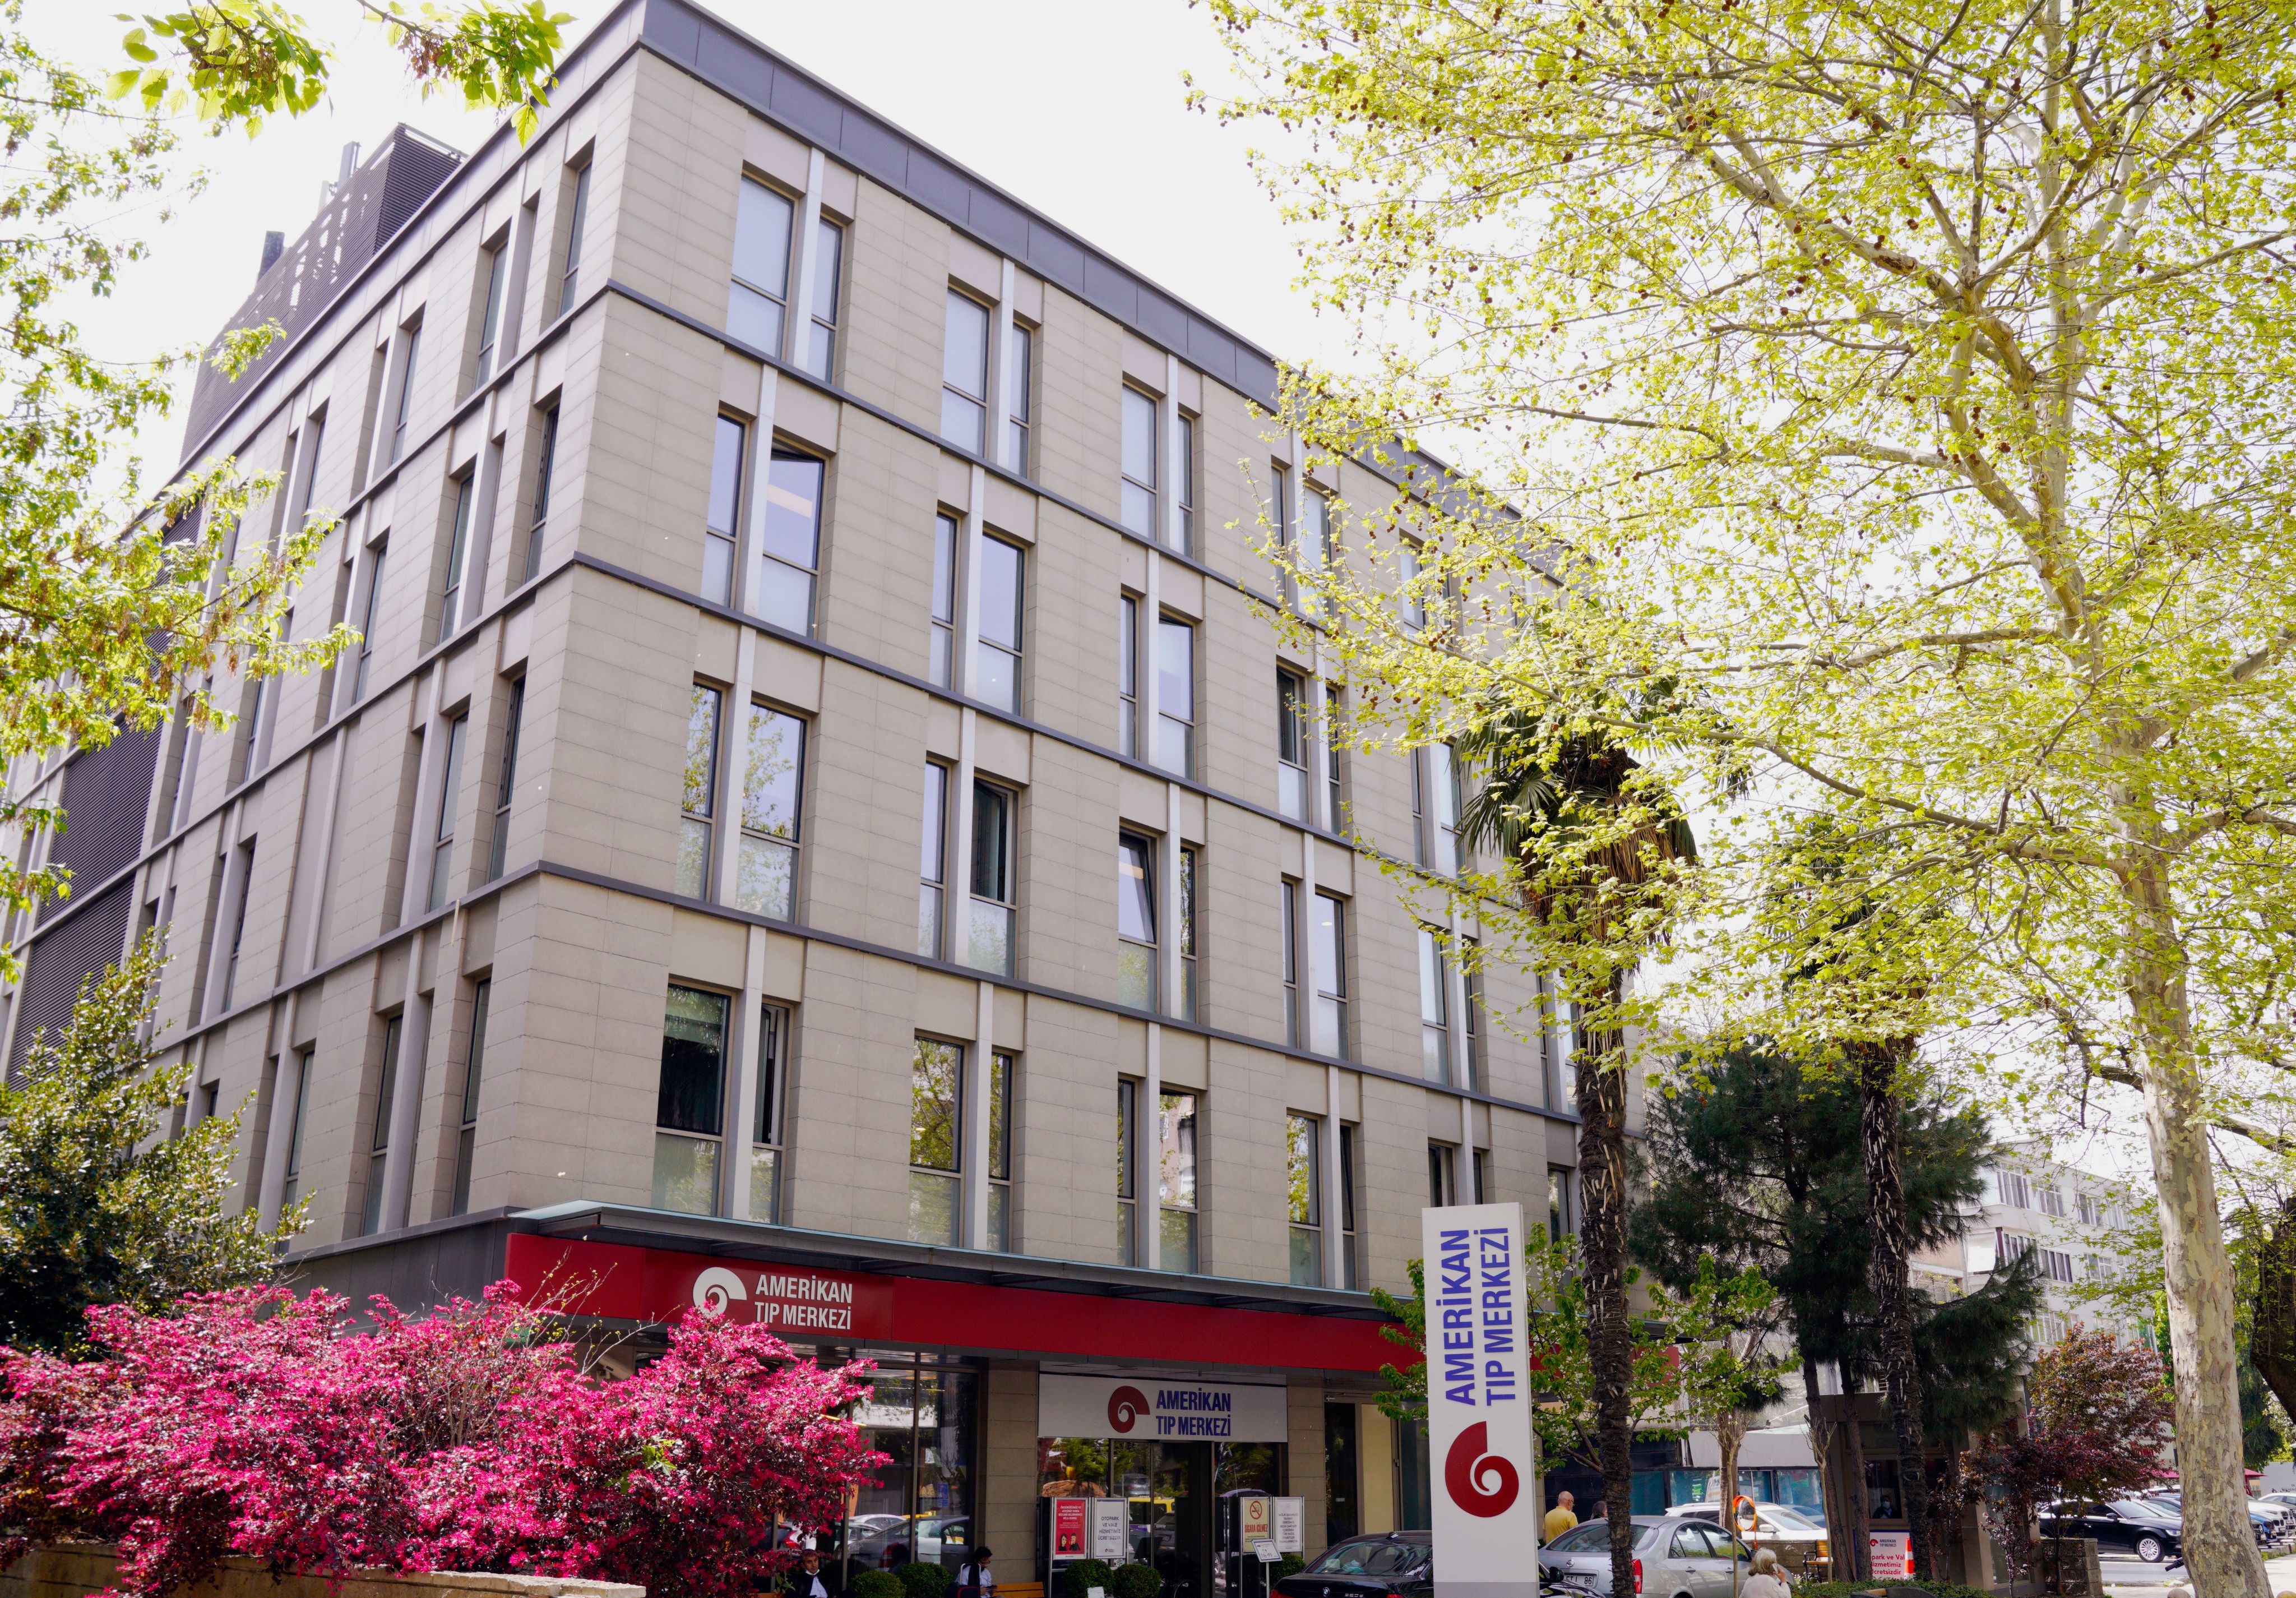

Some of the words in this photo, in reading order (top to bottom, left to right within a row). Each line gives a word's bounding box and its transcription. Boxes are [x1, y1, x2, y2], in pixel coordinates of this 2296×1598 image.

[755, 1274, 852, 1303] AMERİKAN
[1474, 1228, 1513, 1352] MERKEZİ
[754, 1301, 780, 1323] TIP
[783, 1304, 851, 1329] MERKEZİ
[1436, 1230, 1475, 1406] AMERİKAN
[1485, 1360, 1515, 1406] TIP
[1156, 1388, 1231, 1411] AMERİKAN
[1156, 1416, 1175, 1434] TIP
[1178, 1414, 1230, 1436] MERKEZİ
[1245, 1522, 1256, 1532] SİGARA
